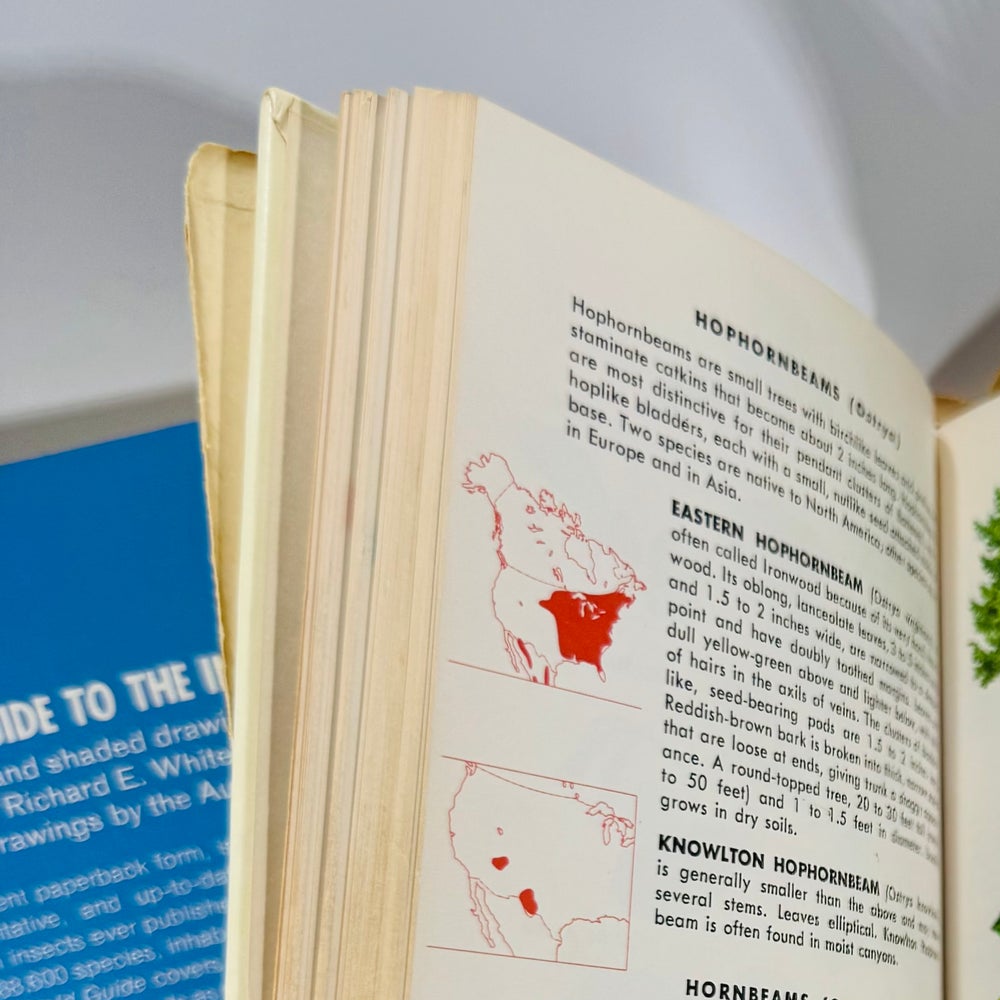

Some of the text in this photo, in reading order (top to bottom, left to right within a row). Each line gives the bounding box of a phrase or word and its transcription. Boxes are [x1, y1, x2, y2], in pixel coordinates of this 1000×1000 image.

[572, 295, 692, 363] Hophornbeams
[698, 355, 721, 377] are
[728, 367, 763, 396] small
[768, 383, 798, 414] trees
[801, 403, 826, 429] with
[694, 309, 842, 402] HOPHORNBEAMS
[566, 419, 741, 503] in Europe and in Asia.
[671, 527, 867, 619] often called Ironwood because
[672, 499, 863, 595] EASTERN HOPHORNBEAM
[670, 552, 715, 579] wood.
[722, 565, 737, 587] Its
[744, 578, 792, 609] oblong,
[797, 595, 855, 634] lanceolate
[58, 680, 117, 728] TO
[121, 661, 196, 712] THE
[667, 621, 695, 645] dull
[703, 633, 792, 675] yellow-green
[799, 665, 834, 690] above
[840, 679, 859, 701] and
[666, 669, 860, 745] like, seed-bearing pods are
[43, 731, 147, 775] shaded
[664, 719, 860, 791] that are loose at ends, giving
[3, 772, 111, 819] Richard
[106, 803, 141, 829] by
[146, 792, 192, 818] the
[660, 795, 798, 836] grows in dry soils.
[34, 859, 149, 905] paperback
[658, 834, 880, 897] KNOWLTON HOPHORNBEAM
[80, 894, 122, 920] and
[655, 908, 898, 967] beam is often found in moist canyons.
[9, 935, 87, 966] insects
[87, 921, 136, 947] ever
